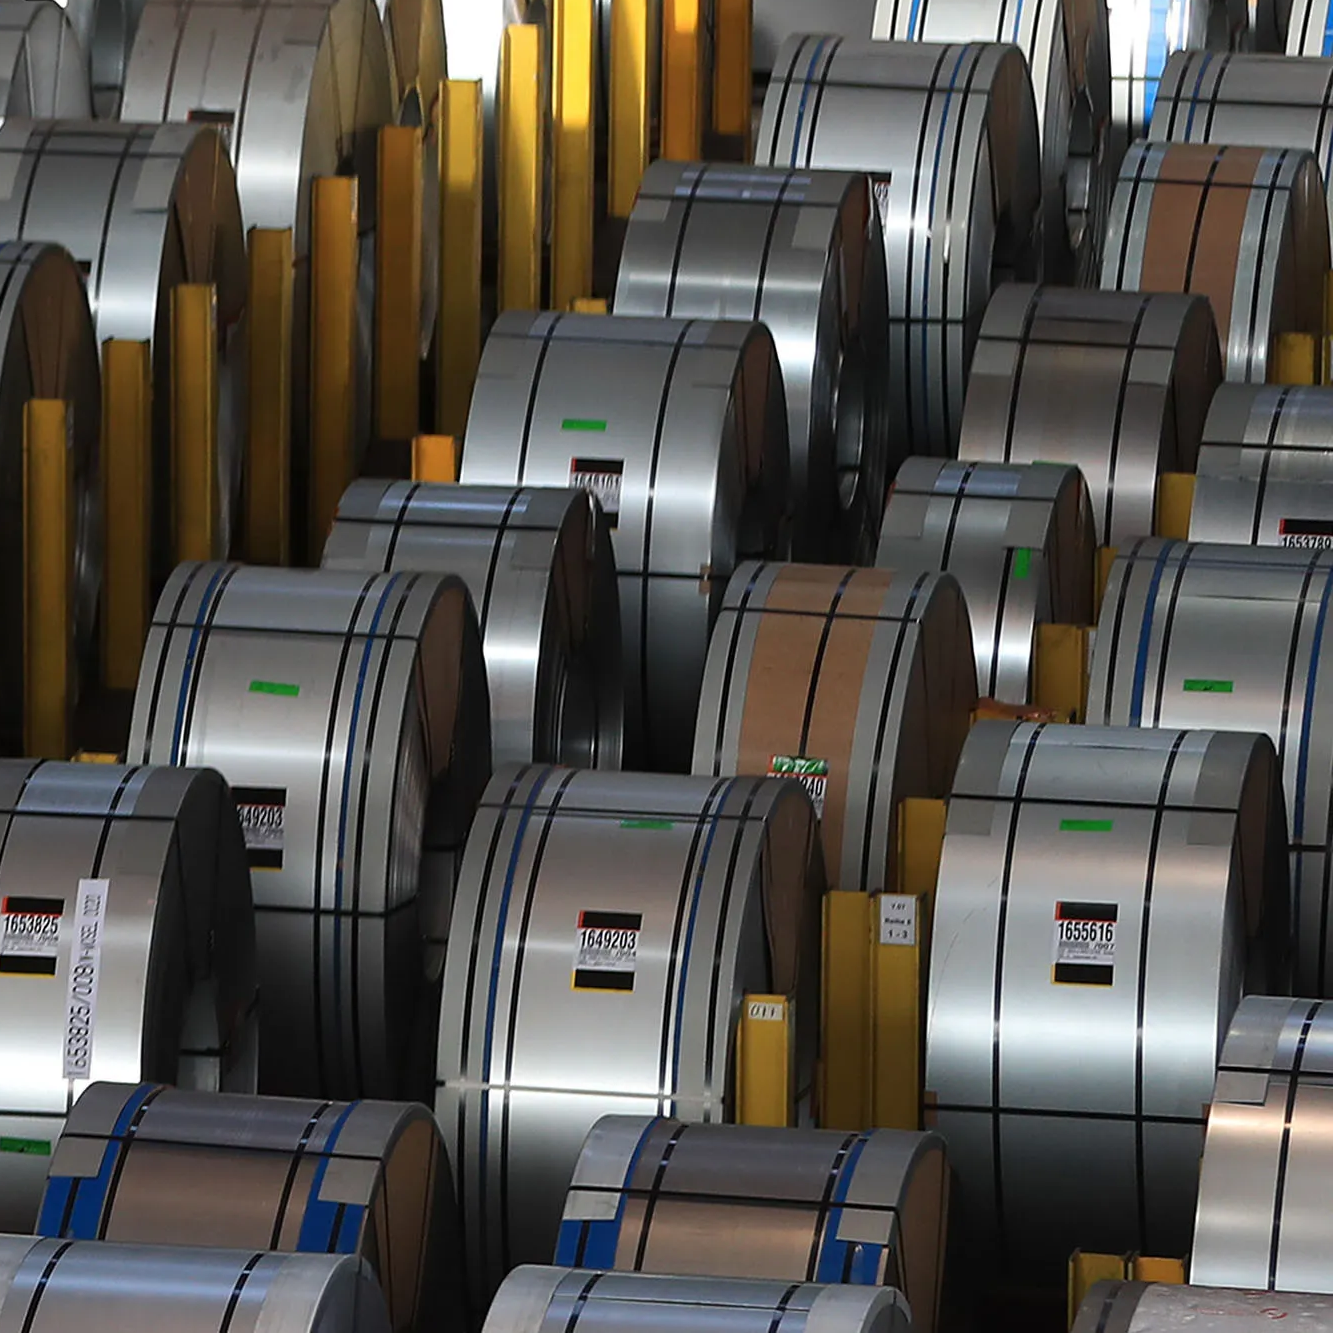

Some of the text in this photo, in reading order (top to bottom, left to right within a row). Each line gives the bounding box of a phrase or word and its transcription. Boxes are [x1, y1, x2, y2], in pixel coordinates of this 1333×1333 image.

[4, 914, 59, 935] 1653825
[1058, 920, 1114, 943] 1655616
[580, 929, 637, 949] 1649203
